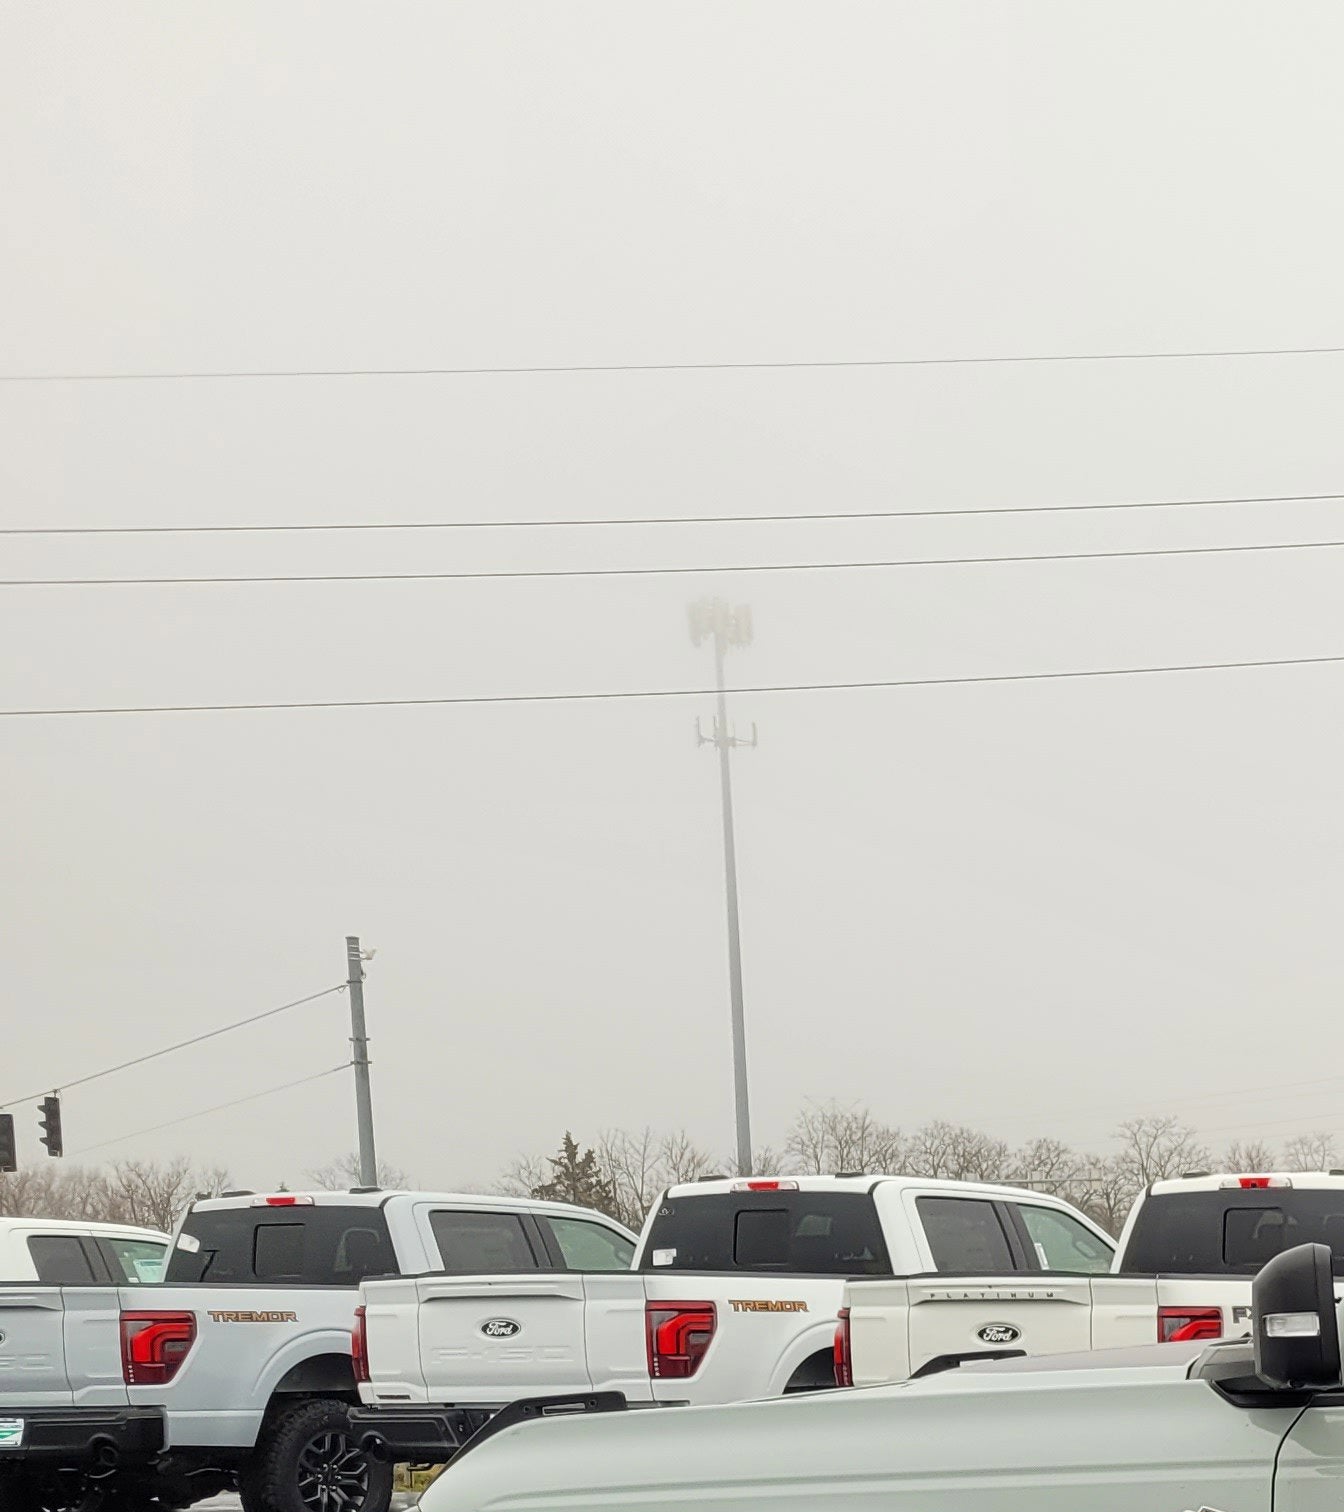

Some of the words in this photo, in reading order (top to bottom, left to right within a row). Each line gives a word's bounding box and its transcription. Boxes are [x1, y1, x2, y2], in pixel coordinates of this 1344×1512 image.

[727, 1299, 810, 1313] TREMOR
[207, 1310, 299, 1323] TREMOR
[484, 1320, 515, 1337] Ford
[981, 1325, 1014, 1342] Ford
